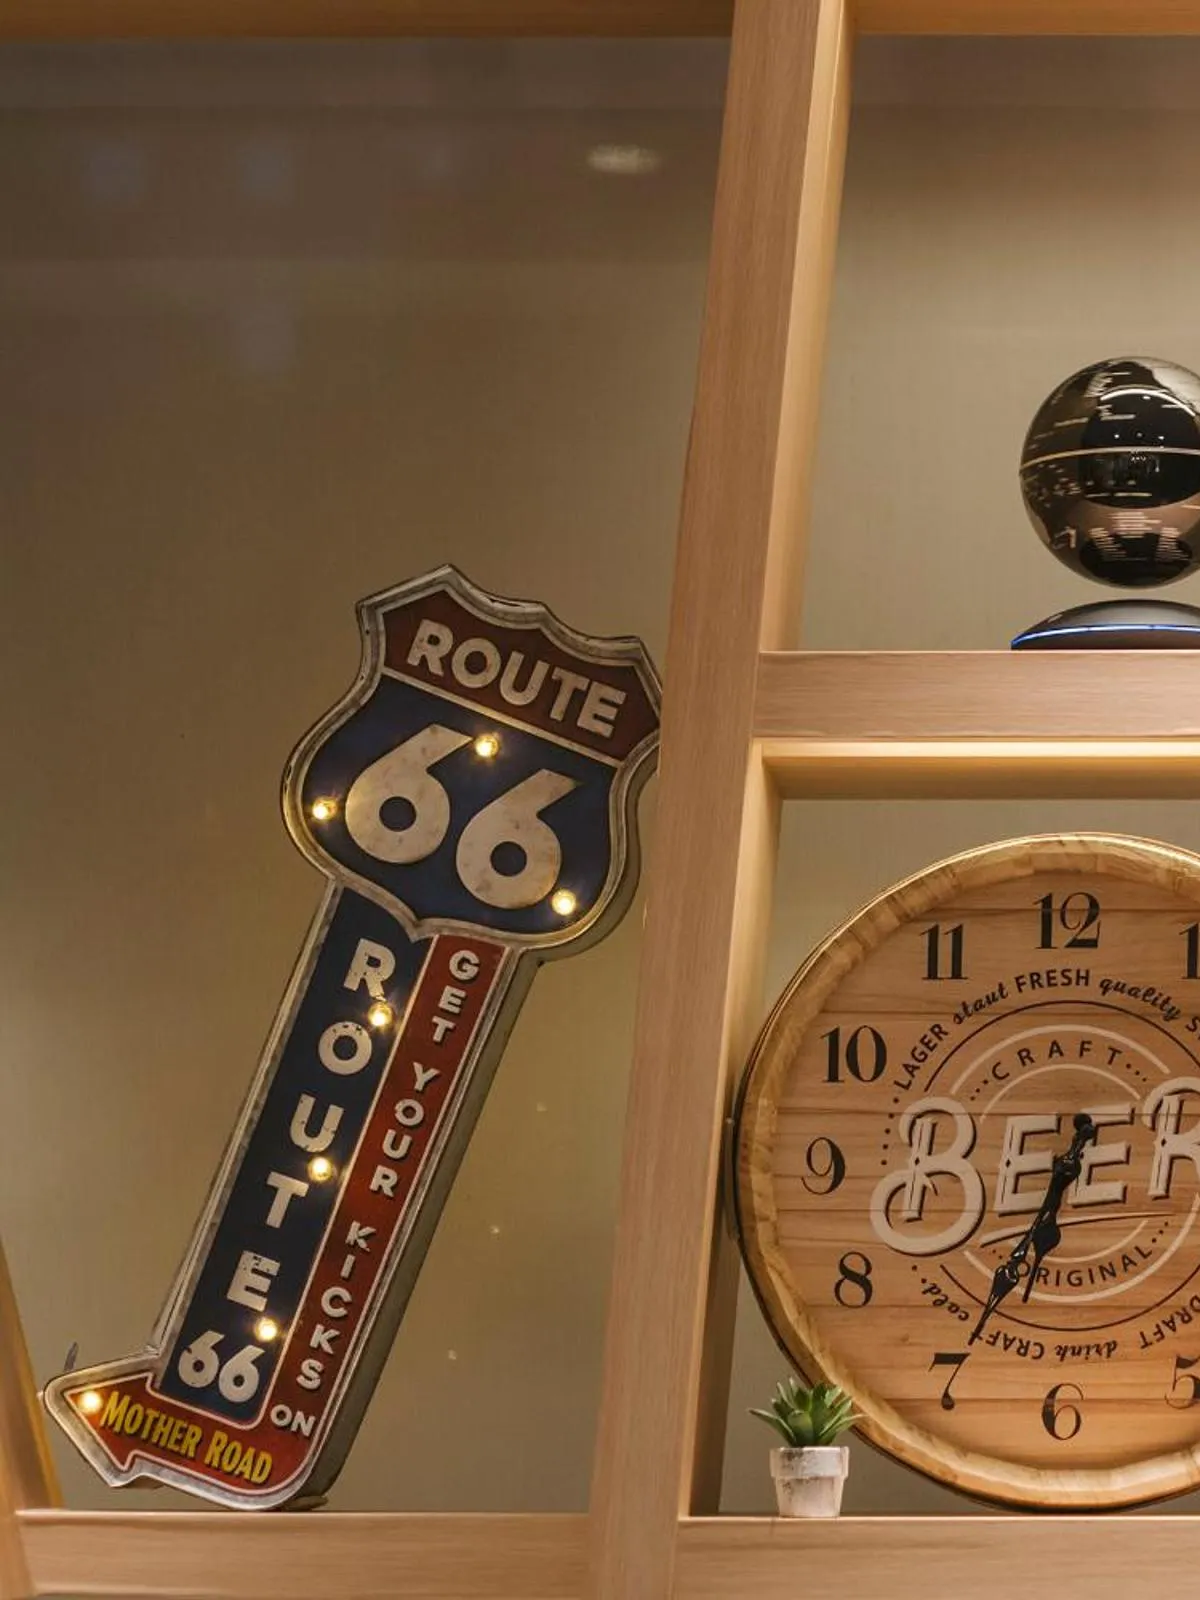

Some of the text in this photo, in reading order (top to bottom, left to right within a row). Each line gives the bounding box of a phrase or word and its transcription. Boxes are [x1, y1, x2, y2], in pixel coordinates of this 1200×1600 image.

[406, 618, 627, 738] ROUTE
[345, 723, 582, 909] 66
[1032, 891, 1100, 951] 12
[919, 922, 969, 981] 11
[819, 1024, 887, 1084] 10
[893, 1023, 949, 1091] LAGER
[1014, 969, 1091, 993] FRESH
[1098, 977, 1181, 1022] quality
[991, 1039, 1123, 1081] CRAFT
[178, 938, 396, 1403] ROUTE 66
[270, 949, 480, 1438] GET YOUR KICKS ON
[801, 1136, 846, 1195] 9
[833, 1250, 874, 1309] 8
[1013, 1245, 1154, 1287] ORIGINAL
[927, 1351, 971, 1411] 7
[100, 1390, 274, 1485] MOTHER ROAD
[1041, 1382, 1085, 1441] 6
